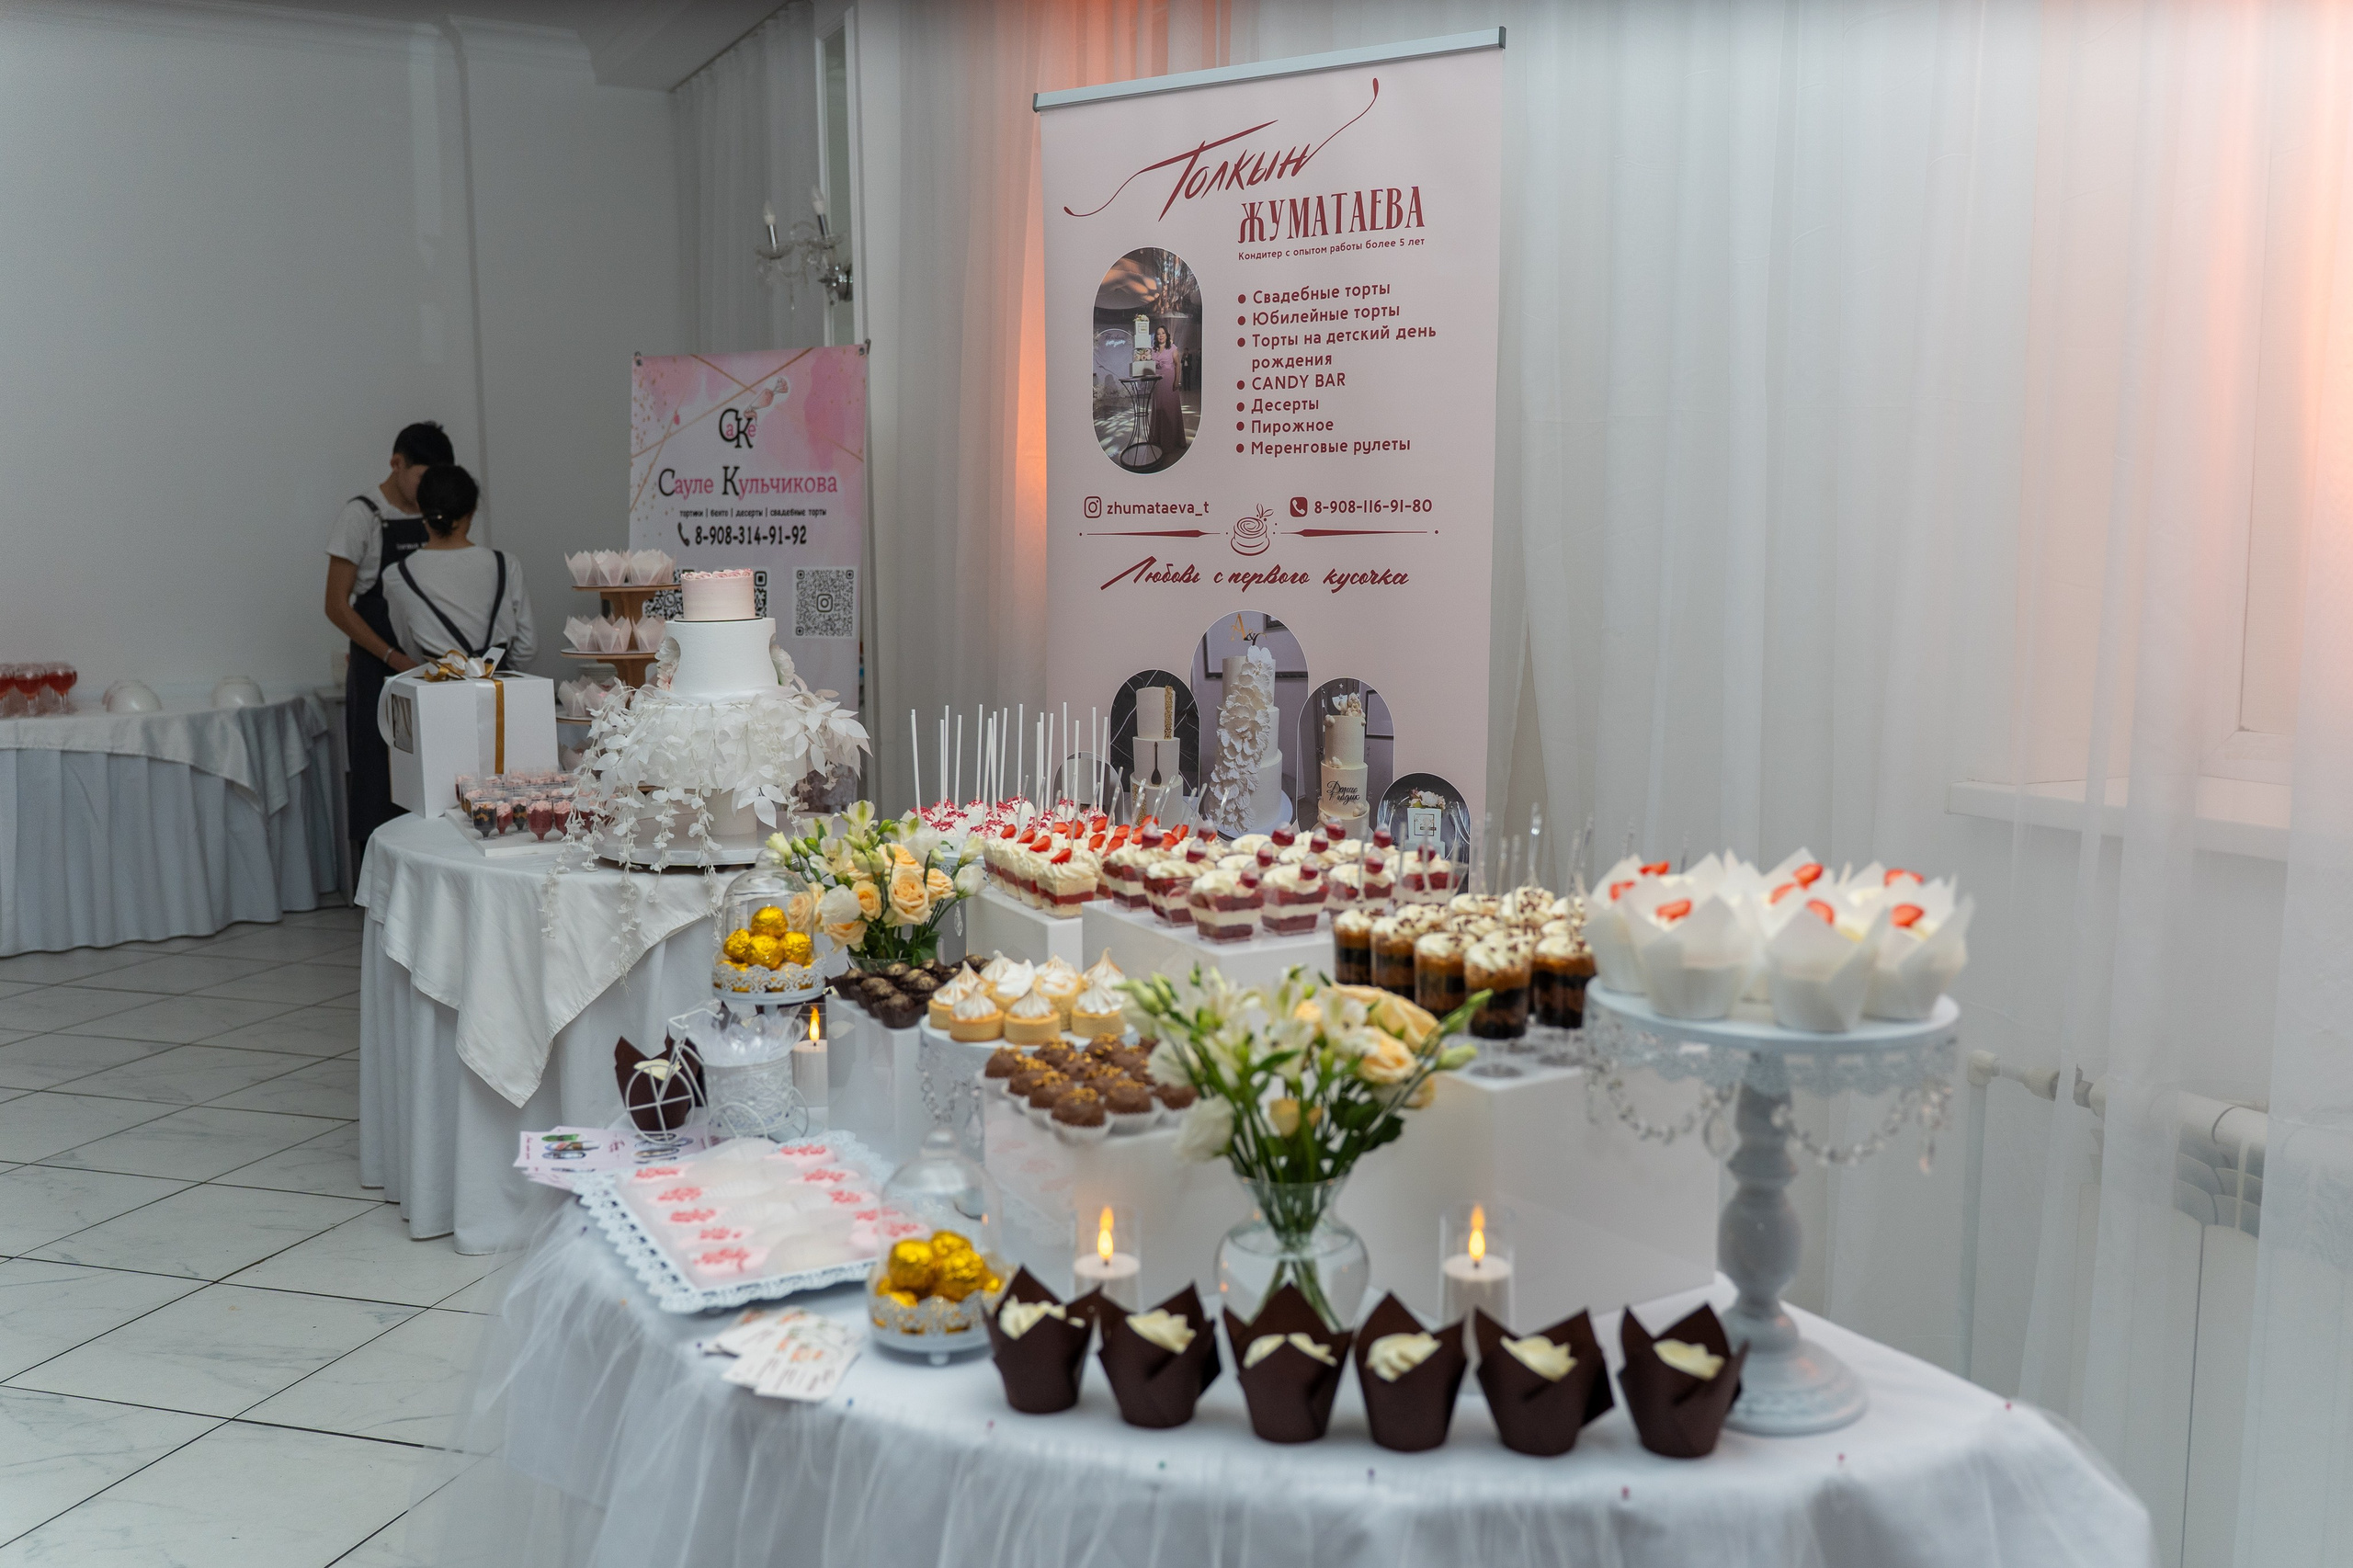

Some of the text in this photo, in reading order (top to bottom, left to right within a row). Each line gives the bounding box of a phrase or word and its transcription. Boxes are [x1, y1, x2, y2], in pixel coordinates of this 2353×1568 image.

[1237, 186, 1426, 244] ЖУМАТАЕВА
[1238, 250, 1283, 261] Кондитер
[1292, 246, 1327, 256] опытом
[1329, 242, 1363, 256] работы
[1365, 239, 1396, 249] более
[1399, 238, 1405, 247] 5
[1407, 238, 1426, 246] лет
[1253, 283, 1391, 304] Свадебные торты
[1253, 305, 1400, 326] Юбилейные торты
[1252, 324, 1437, 350] Торты на детский день
[1252, 354, 1332, 373] рождения
[1251, 372, 1346, 391] CANDY BAR
[1251, 398, 1319, 415] Десерты
[1251, 419, 1334, 437] Пирожное
[1251, 439, 1411, 459] Меренговые рулеты
[657, 465, 838, 501] Сауле Кульчикова
[735, 509, 764, 519] десерты
[808, 508, 827, 518] торты
[1107, 501, 1210, 517] zhumataeva_t
[1313, 498, 1433, 515] 8-908-116-91-80
[695, 525, 807, 546] 8-908-314-91-92
[1099, 555, 1410, 595] Любовь с первого кусочка
